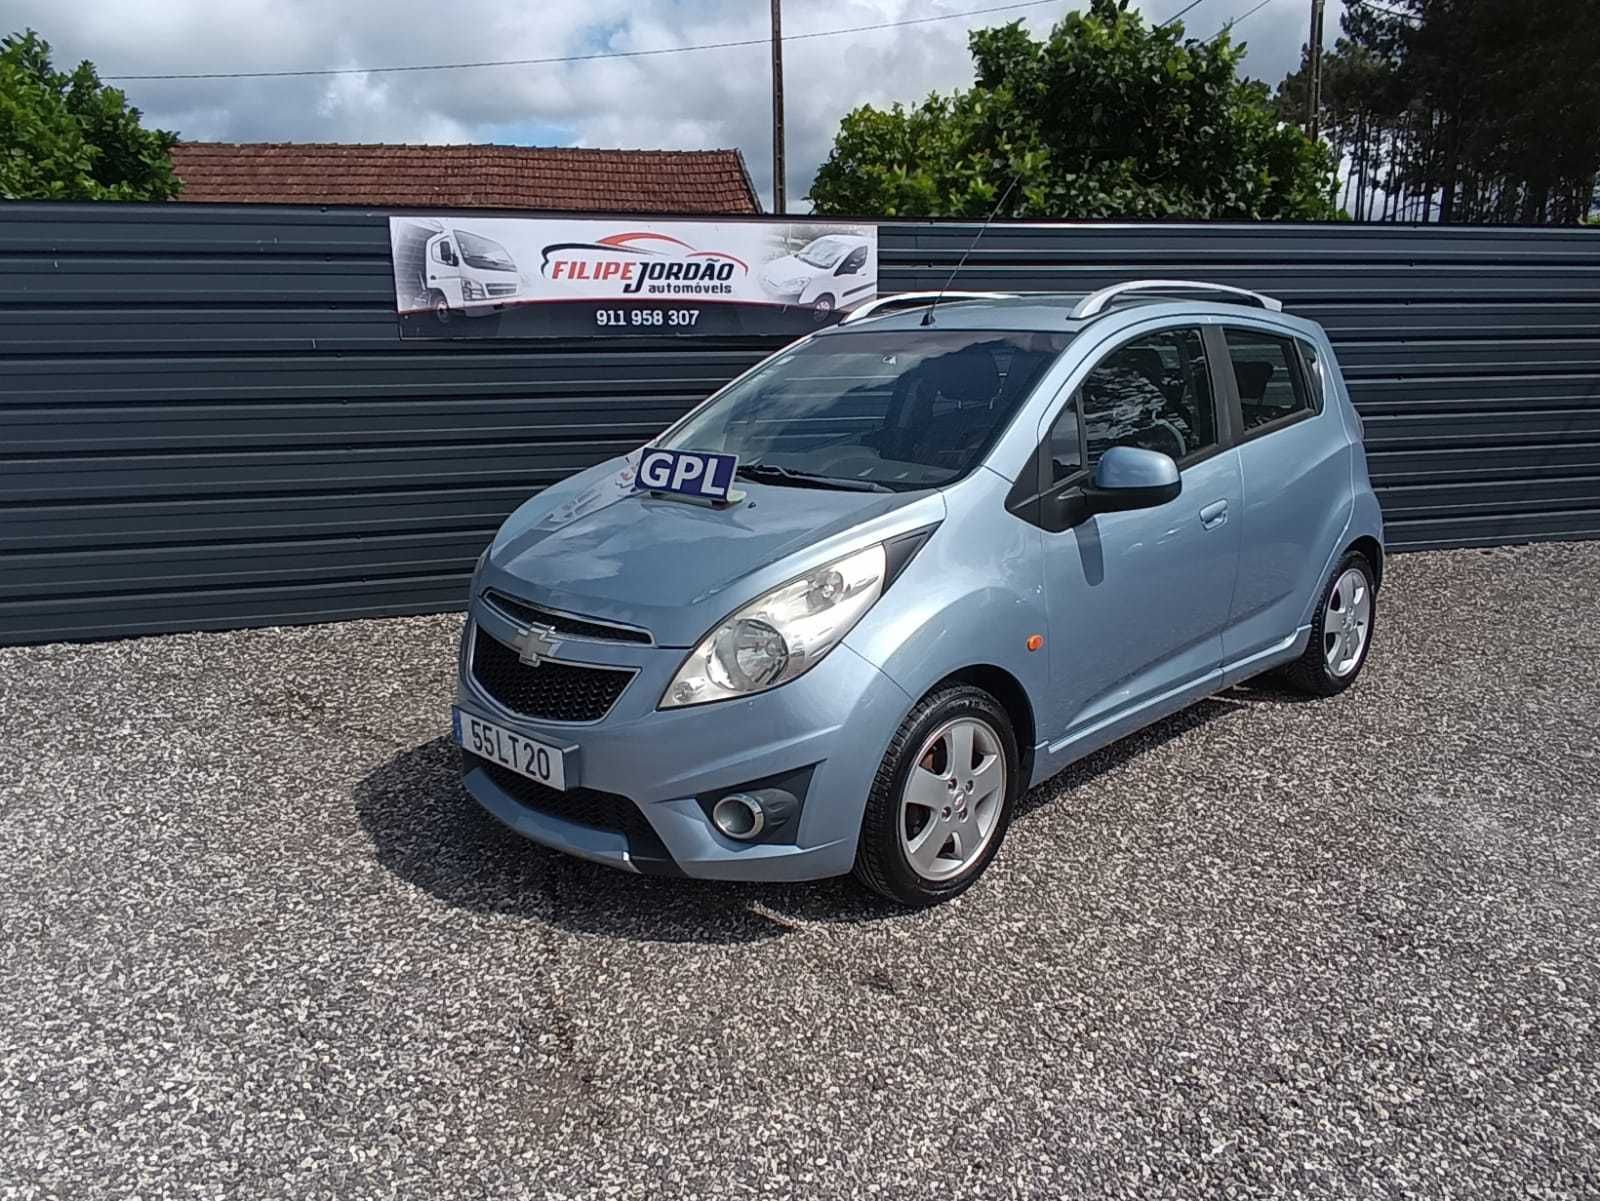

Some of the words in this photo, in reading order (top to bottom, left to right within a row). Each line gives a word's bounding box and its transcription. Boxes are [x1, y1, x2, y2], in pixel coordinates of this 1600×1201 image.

[552, 261, 637, 280] FILIPE
[648, 282, 733, 294] automóveis
[596, 310, 627, 326] 911
[631, 310, 663, 326] 958
[668, 310, 700, 326] 307
[640, 452, 725, 496] GPL
